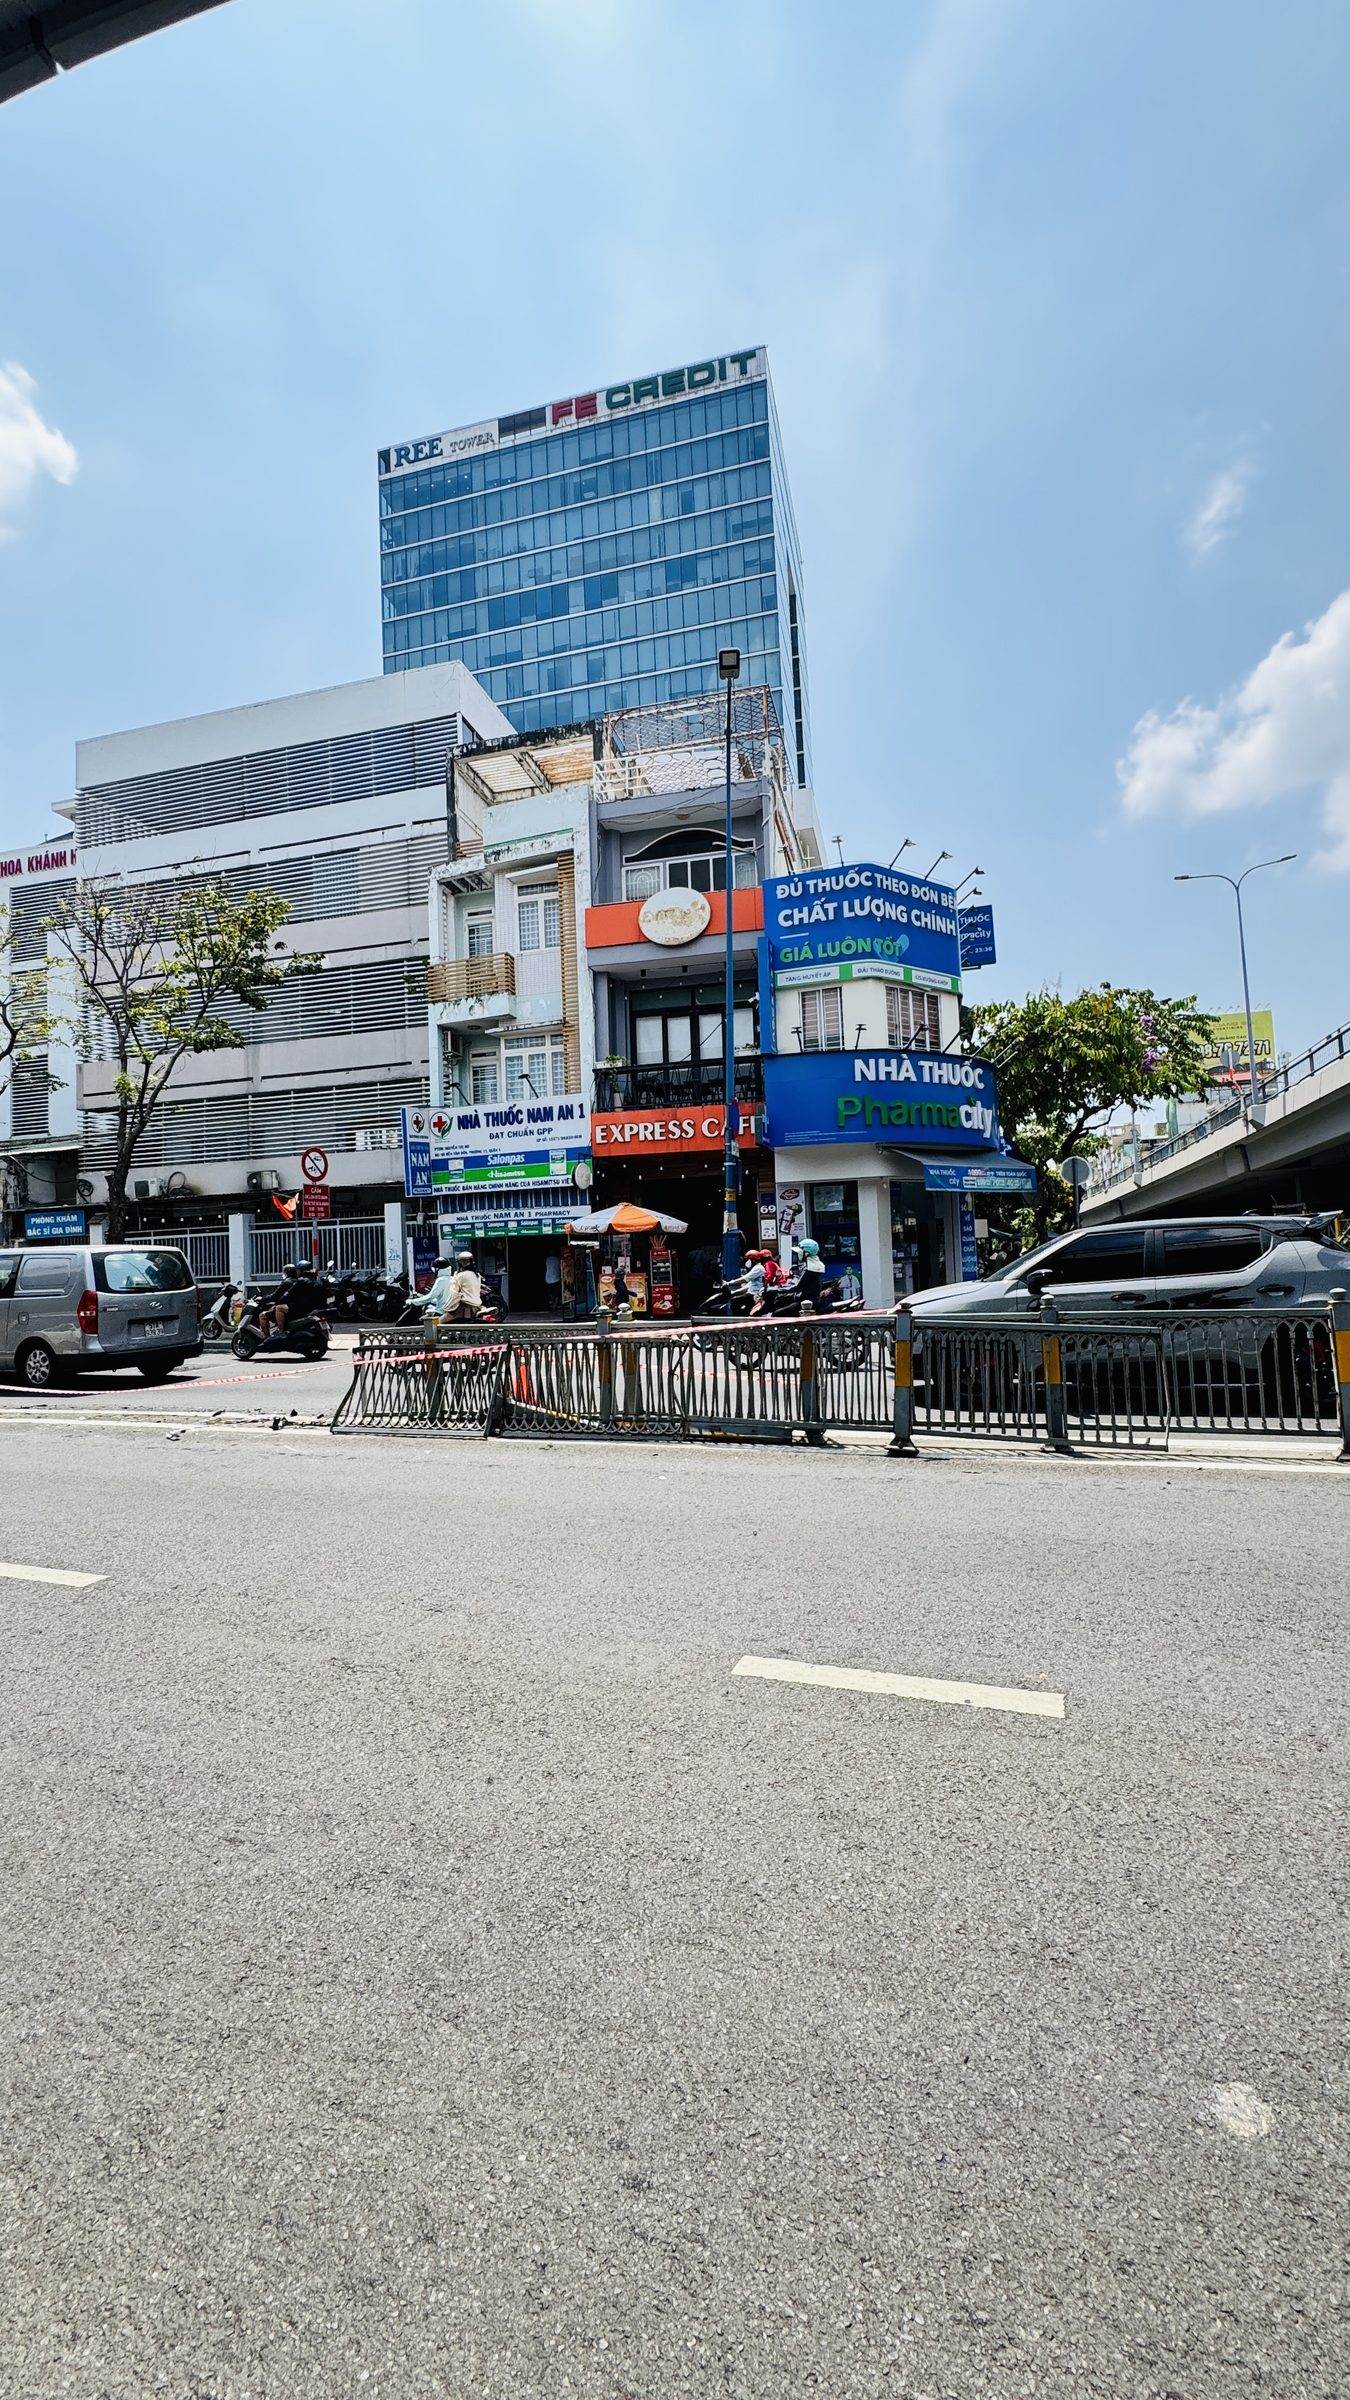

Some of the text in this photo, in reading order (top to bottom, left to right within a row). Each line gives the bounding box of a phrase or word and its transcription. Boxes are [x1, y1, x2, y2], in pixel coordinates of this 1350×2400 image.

[552, 350, 756, 425] FE CREDIT
[394, 432, 494, 467] REE TOWER
[28, 850, 66, 872] KHÁNH
[776, 878, 803, 900] ĐỦ
[806, 867, 873, 896] THUỐC
[874, 872, 909, 896] THEO
[911, 884, 939, 905] ĐƠN
[778, 896, 957, 936] CHẤT LƯỢNG CHÍNH
[779, 935, 902, 963] GIÁ LUÔN TỐT
[854, 1053, 985, 1089] NHÀ THUỐC
[457, 1103, 586, 1130] NHÀ THUỐC NAM AN 1
[836, 1095, 993, 1138] Pharmacity
[507, 1127, 534, 1139] CHUẨN
[537, 1127, 554, 1136] GPP
[595, 1119, 694, 1144] EXPRESS
[411, 1152, 430, 1167] NAM
[487, 1154, 525, 1166] Salonpas
[416, 1172, 428, 1185] AN
[445, 1182, 461, 1192] THUỐC
[532, 1178, 560, 1186] HISAMITSU
[31, 1214, 77, 1224] PHÒNG KHÁM
[494, 1211, 511, 1219] NAM
[760, 1205, 776, 1214] 69
[27, 1227, 41, 1236] BÁC
